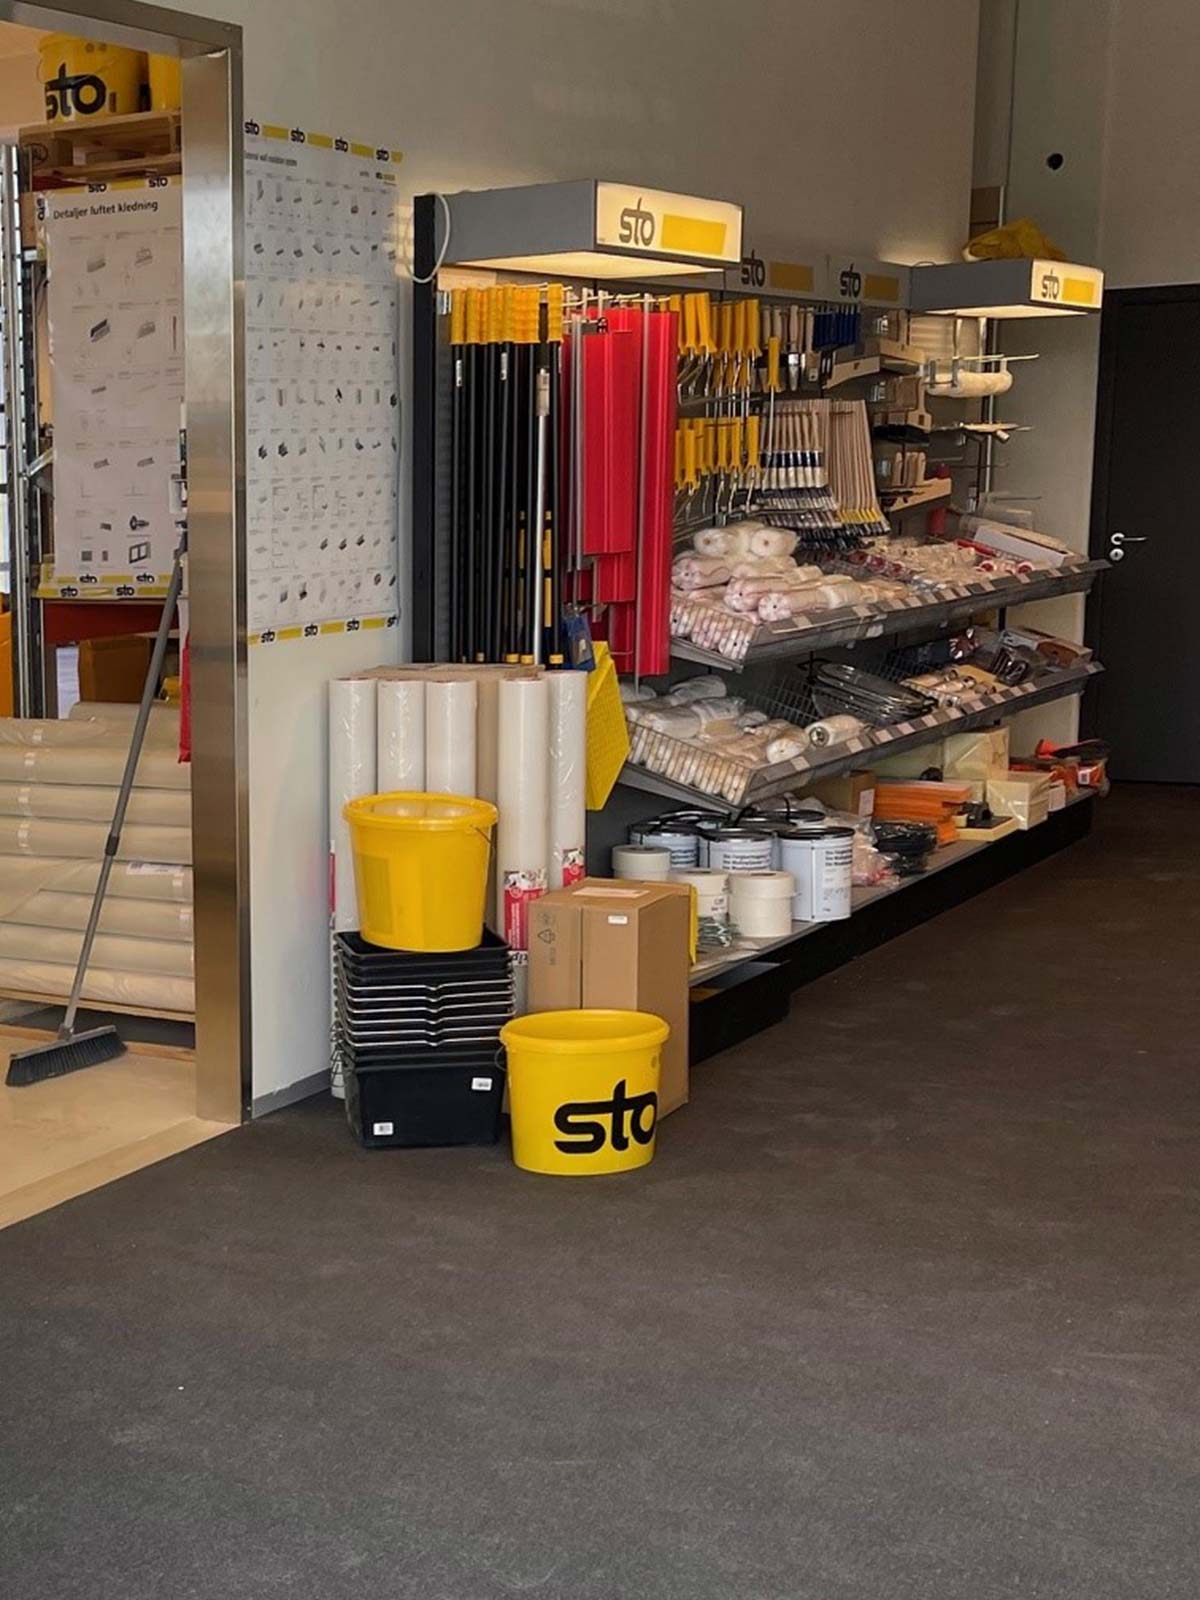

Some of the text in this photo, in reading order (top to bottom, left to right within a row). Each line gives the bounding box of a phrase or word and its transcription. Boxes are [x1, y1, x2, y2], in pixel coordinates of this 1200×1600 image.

[244, 119, 390, 161] sto sto sto sto
[53, 200, 159, 220] Detaljer luftet kledning
[619, 197, 655, 246] sto
[741, 249, 765, 288] sto
[840, 263, 862, 299] sto
[1040, 269, 1060, 300] sto
[60, 584, 135, 597] sto sto
[261, 614, 399, 643] sto sto sto st
[553, 1079, 658, 1155] sto
